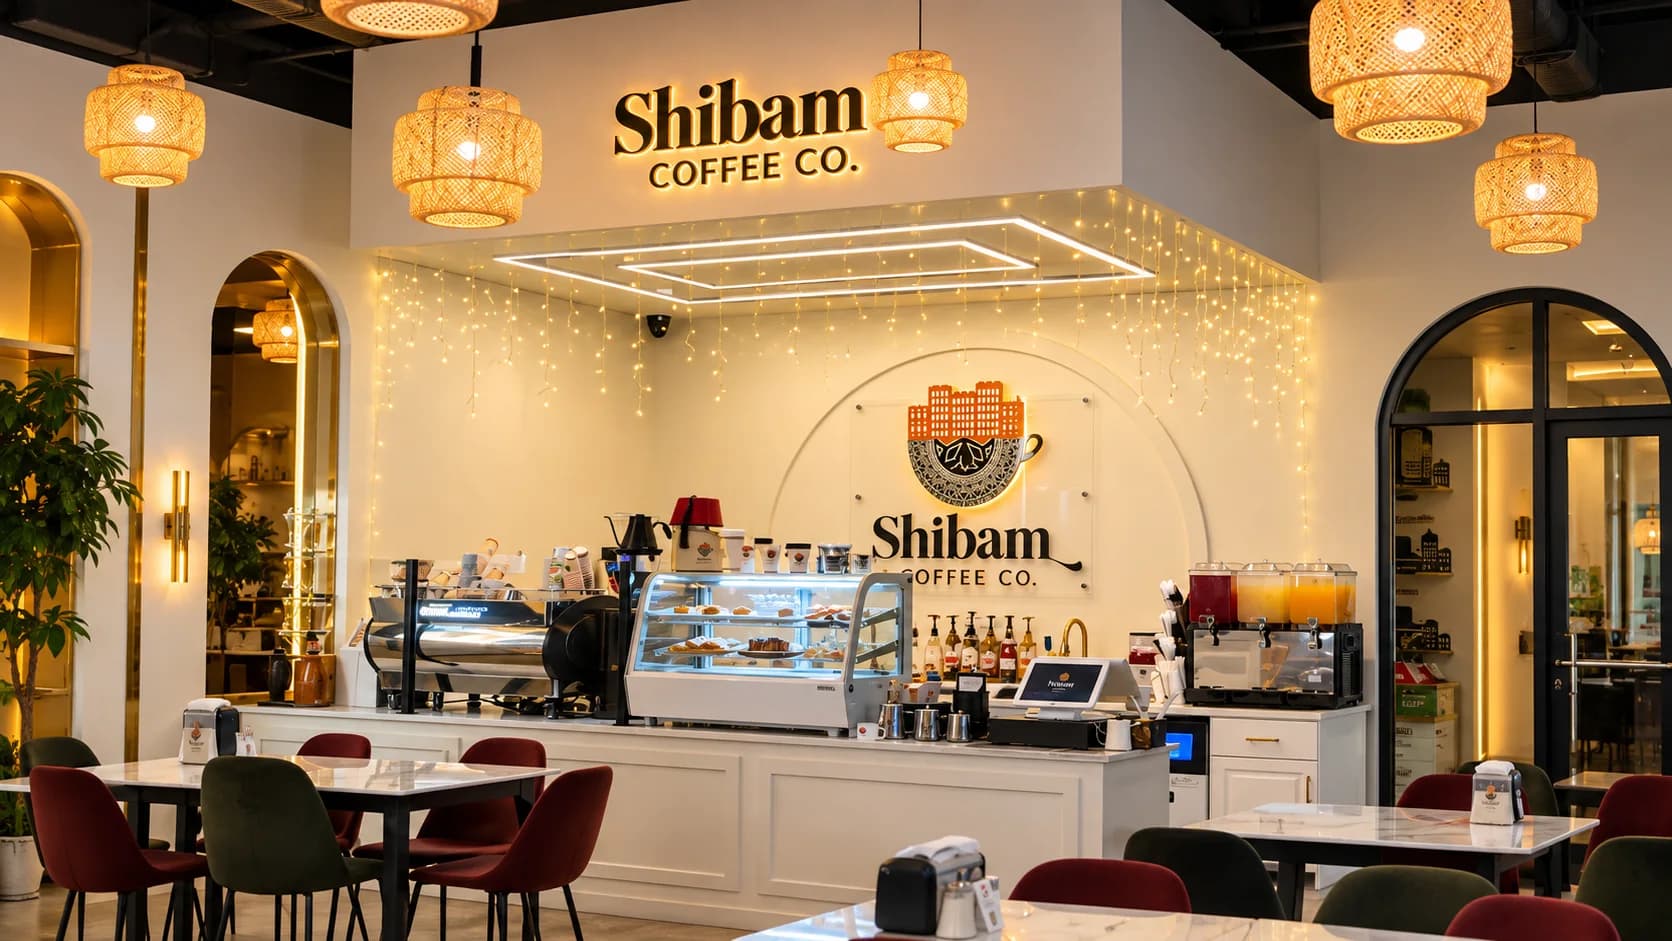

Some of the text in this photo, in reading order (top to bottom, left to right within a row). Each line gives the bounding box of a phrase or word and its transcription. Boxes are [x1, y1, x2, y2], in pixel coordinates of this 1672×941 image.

[614, 78, 868, 155] Shibam
[649, 146, 859, 188] COFFEE CO.
[872, 513, 1083, 572] Shibam
[902, 569, 1037, 586] OFFEE CO.
